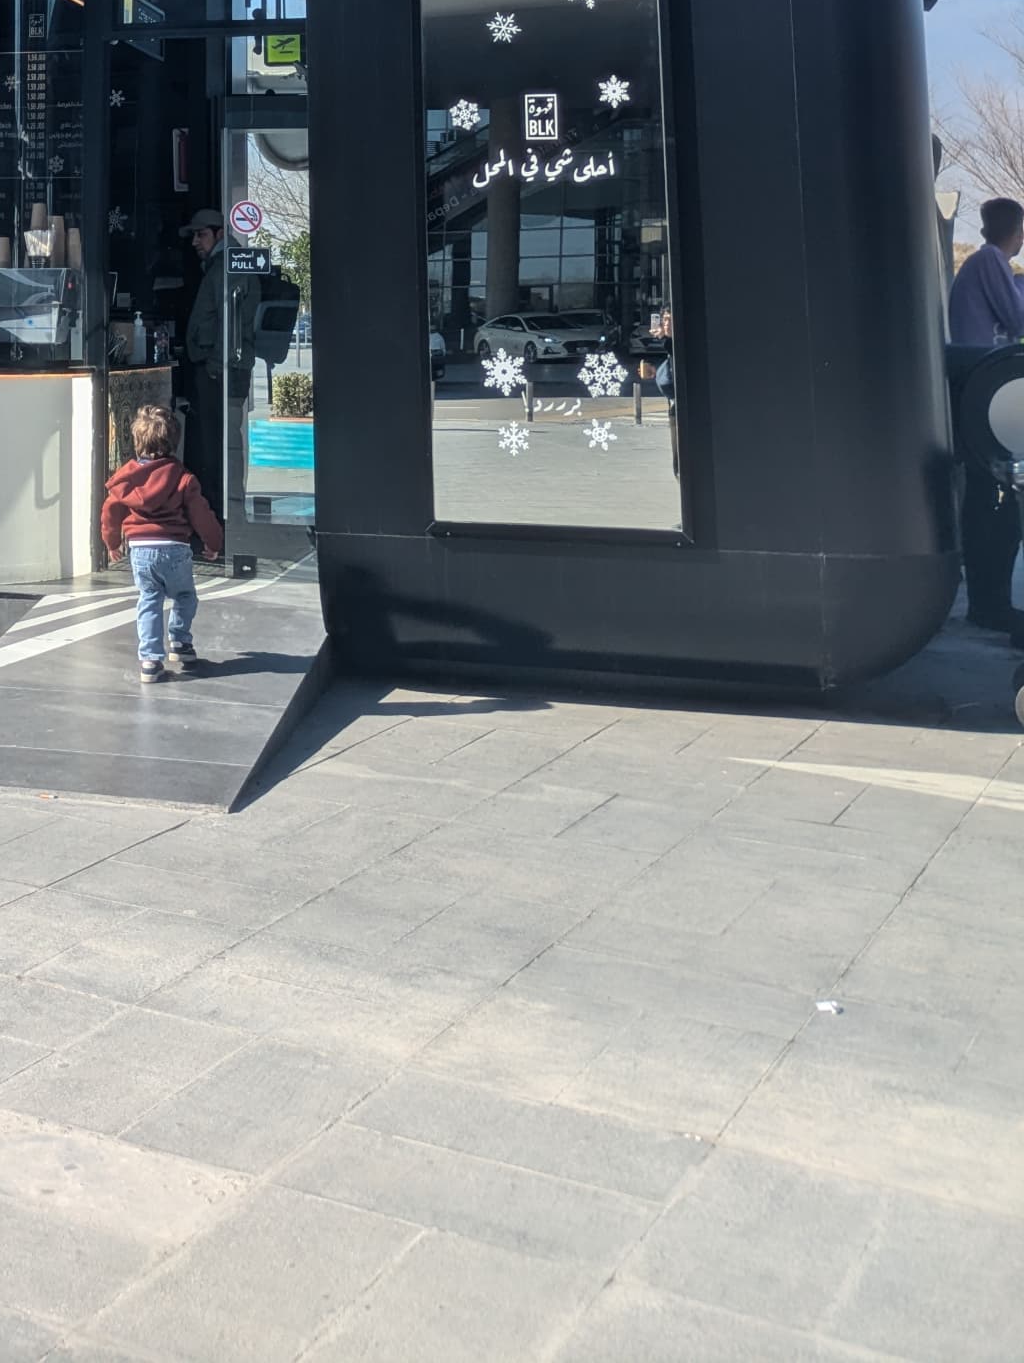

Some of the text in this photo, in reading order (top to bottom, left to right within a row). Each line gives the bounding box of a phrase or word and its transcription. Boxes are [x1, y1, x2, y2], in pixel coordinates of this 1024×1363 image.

[528, 97, 553, 117] قهوة
[529, 119, 554, 136] BLK
[473, 148, 615, 188] أحلى شي في المحل
[231, 251, 254, 260] اسحب
[231, 261, 254, 269] PULL
